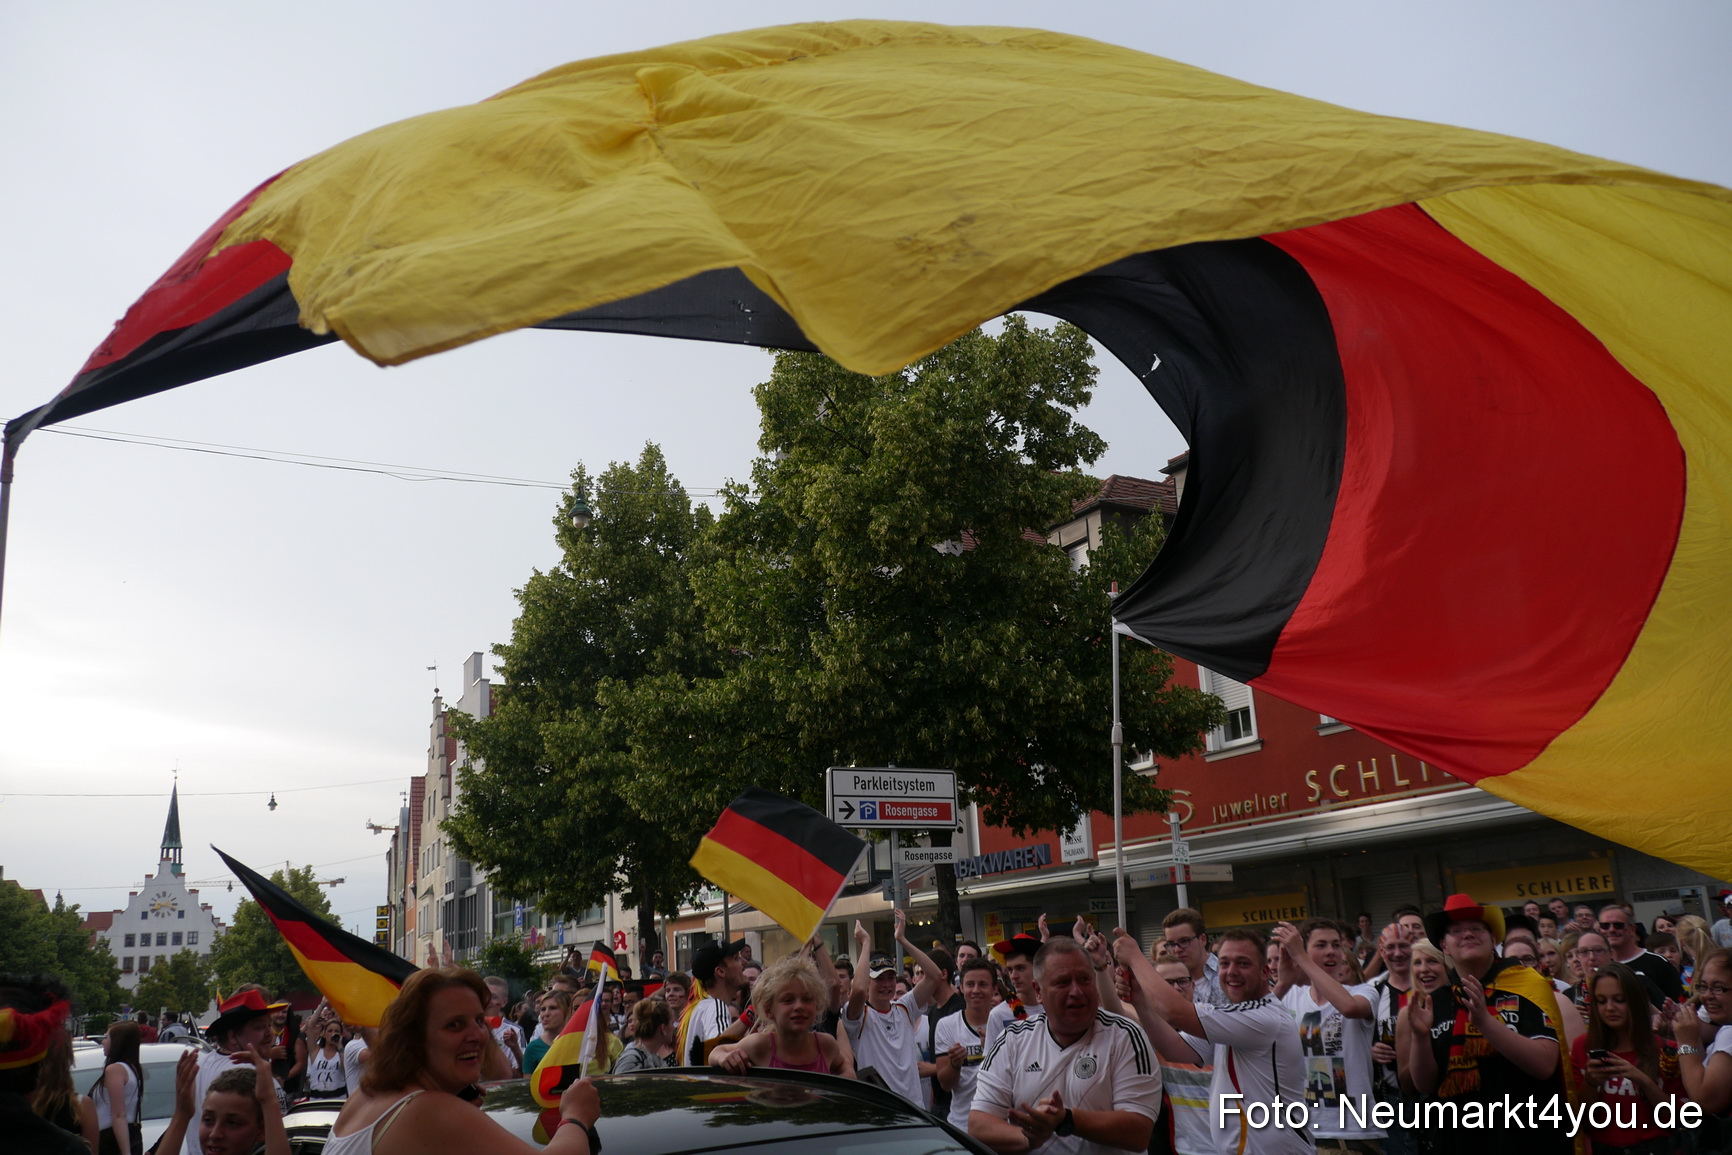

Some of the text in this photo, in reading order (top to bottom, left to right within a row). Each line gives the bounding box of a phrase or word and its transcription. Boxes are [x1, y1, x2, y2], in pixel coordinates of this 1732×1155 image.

[854, 776, 935, 795] Parkleitsystem
[1305, 753, 1455, 802] SCHLI
[885, 804, 938, 819] Rosengasse
[905, 850, 953, 863] Rosengasse
[1517, 875, 1612, 897] SCHLIERF
[1242, 906, 1306, 922] SCHLIERF
[1431, 1020, 1456, 1039] DEU
